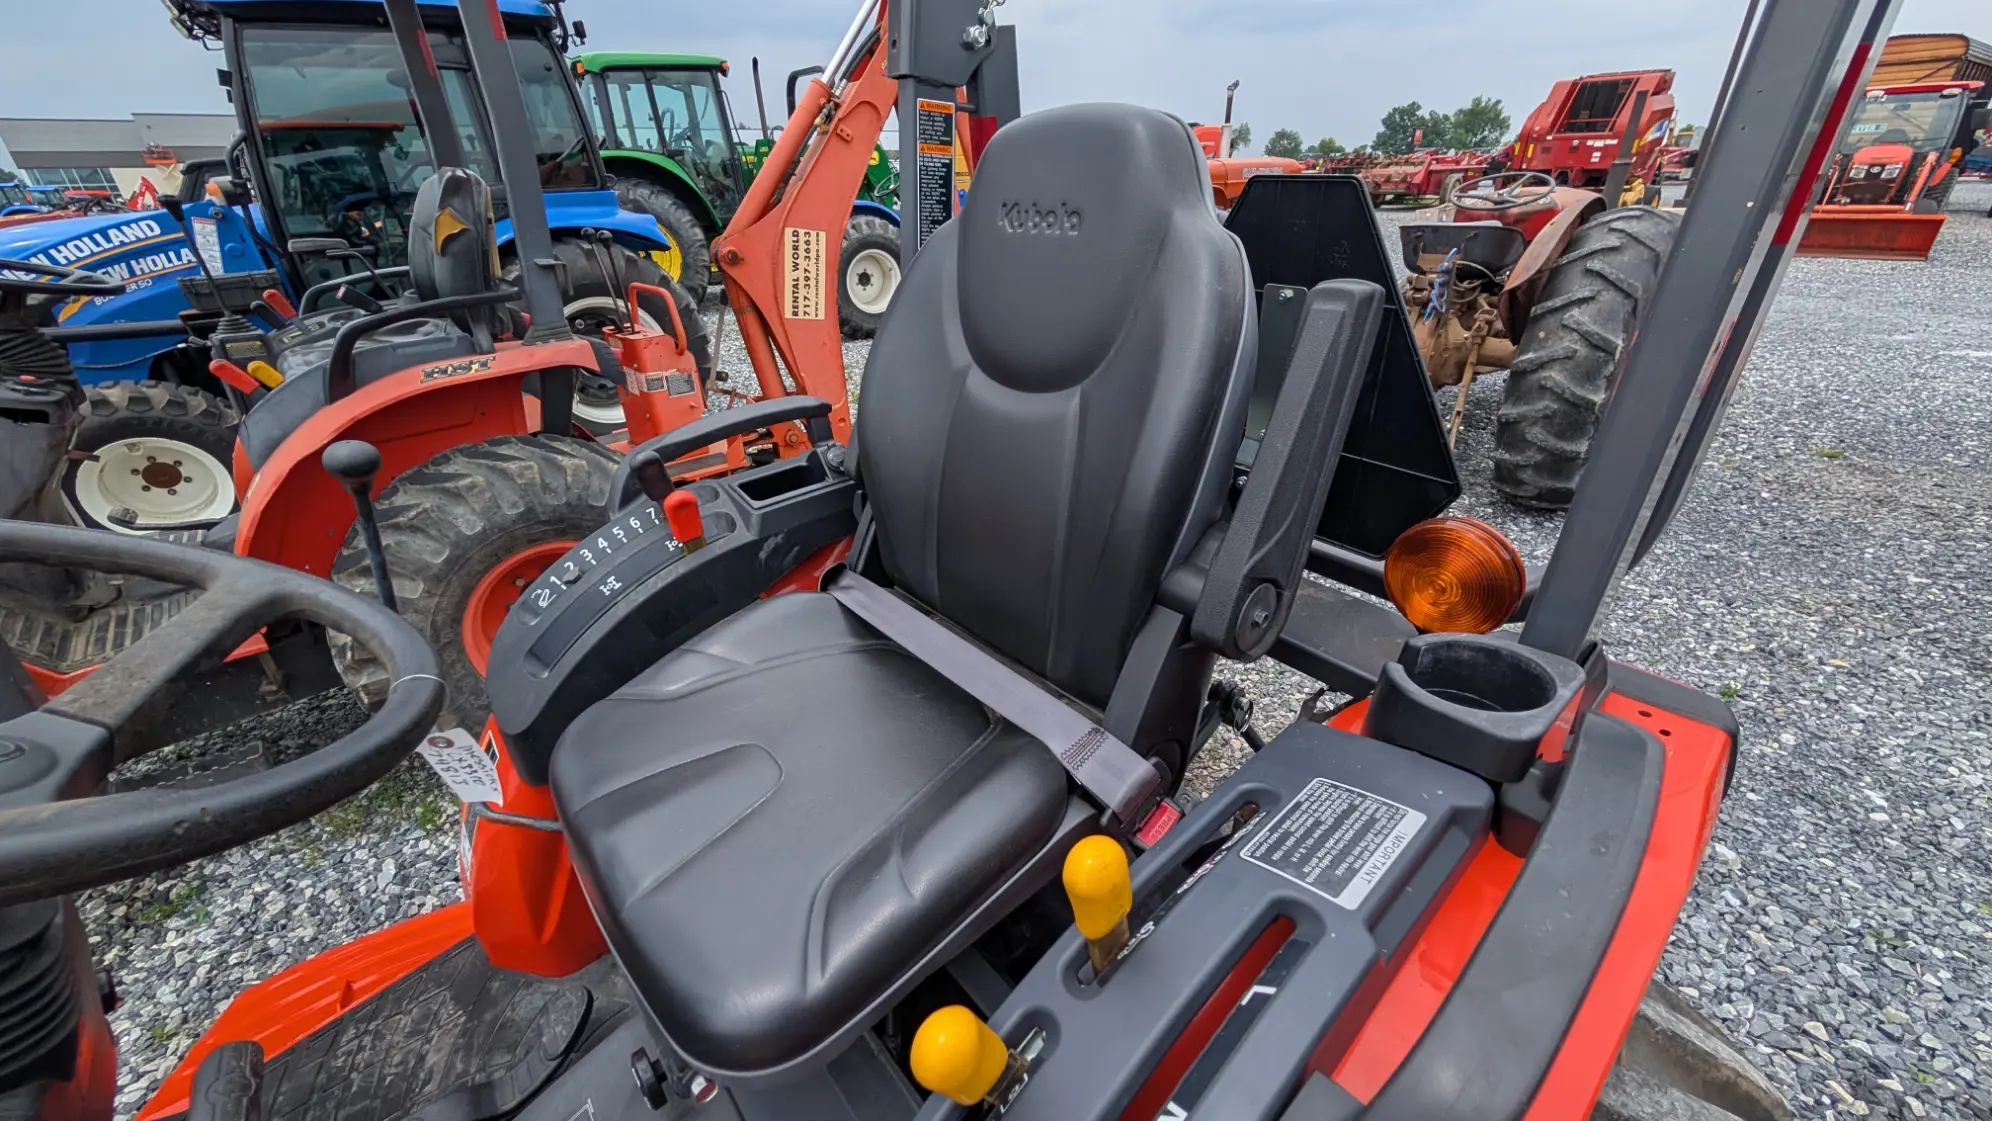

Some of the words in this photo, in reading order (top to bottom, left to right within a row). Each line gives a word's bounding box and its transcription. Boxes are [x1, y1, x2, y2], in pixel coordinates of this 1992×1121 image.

[926, 103, 951, 112] WARNING
[926, 146, 951, 154] WARNING
[997, 202, 1083, 235] Kubota
[49, 219, 161, 265] HOLLAND
[791, 230, 800, 272] WORLD
[803, 231, 812, 317] 717-397-3663
[791, 277, 800, 317] RENTAL
[420, 355, 496, 384] HST
[550, 575, 561, 586] 1
[580, 548, 593, 561] 3
[597, 537, 609, 549] 4
[612, 526, 625, 539] 5
[630, 516, 641, 529] 6
[646, 507, 657, 520] 7
[1151, 815, 1173, 840] PRESS
[1358, 830, 1408, 884] IMPORTANT
[1240, 984, 1277, 1006] L
